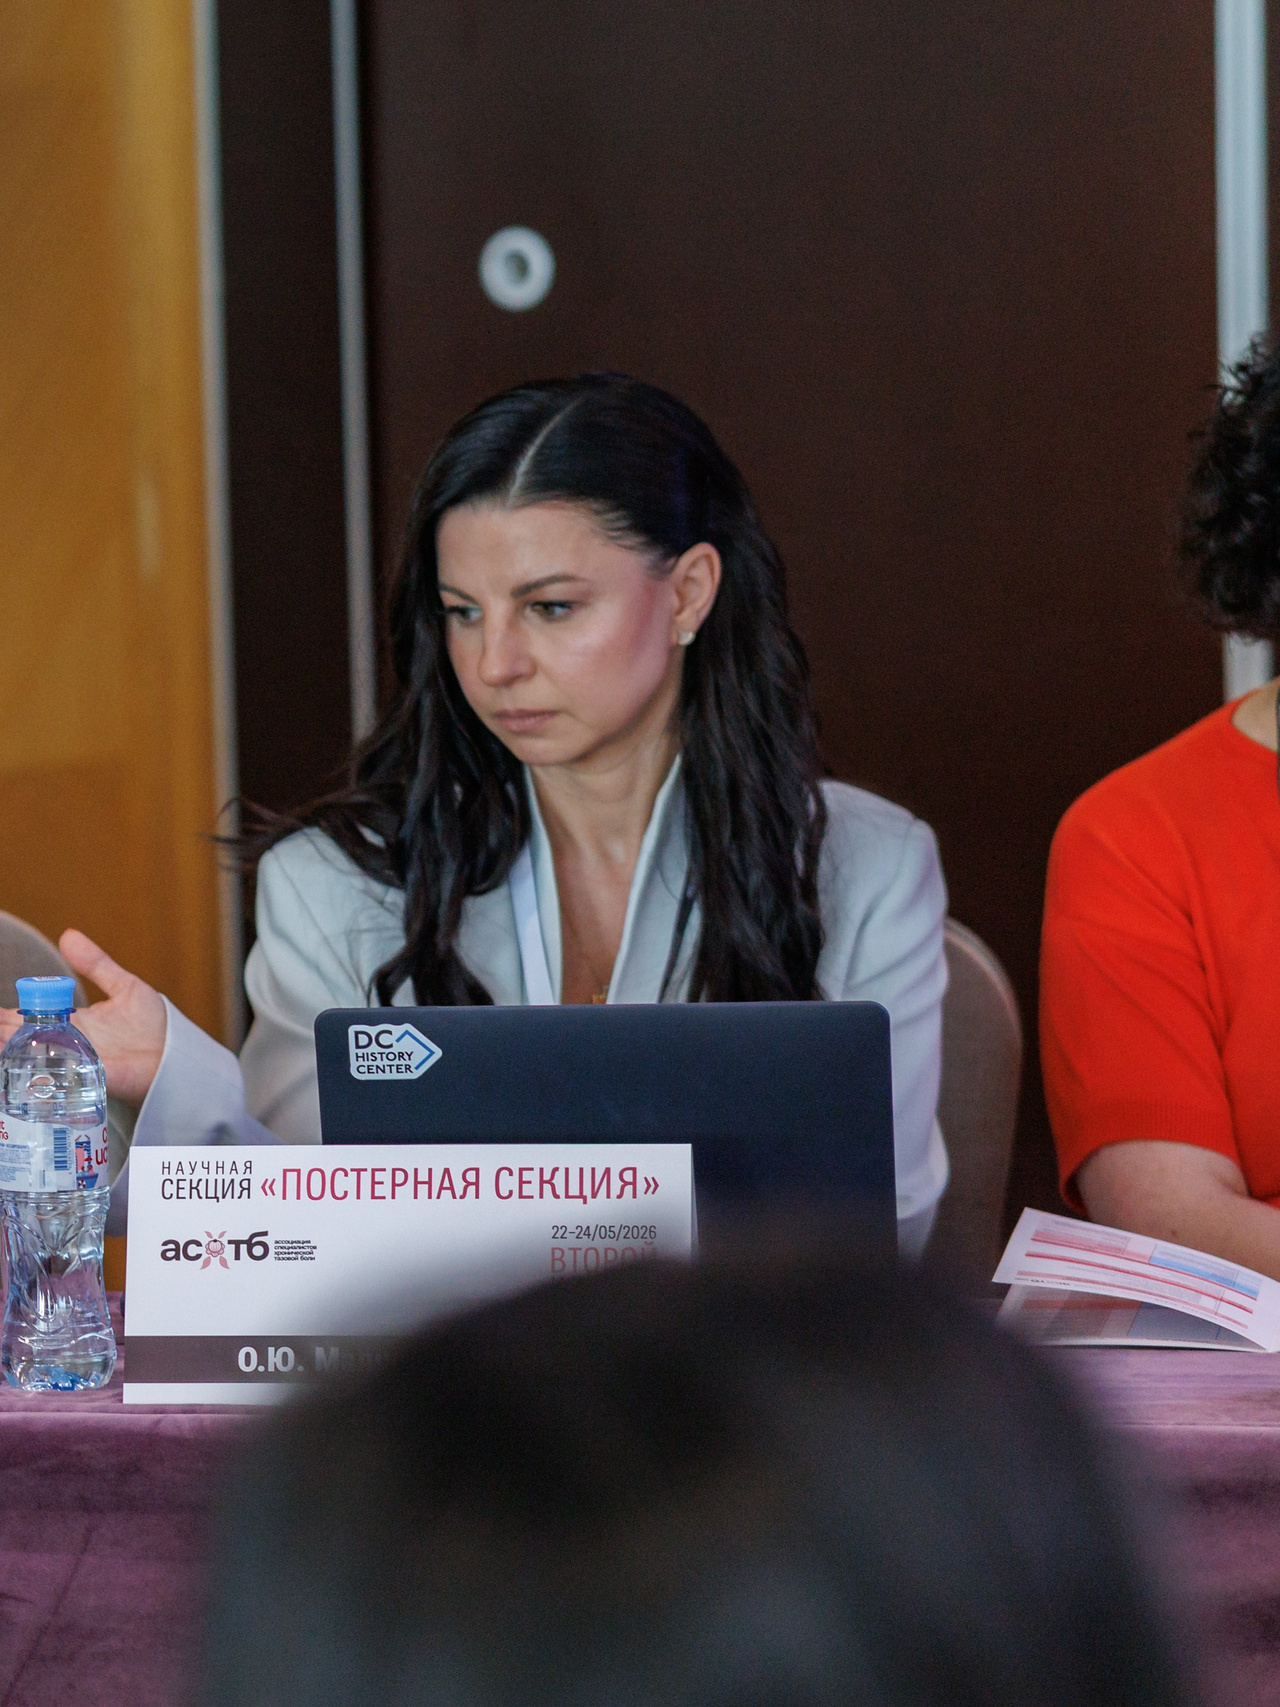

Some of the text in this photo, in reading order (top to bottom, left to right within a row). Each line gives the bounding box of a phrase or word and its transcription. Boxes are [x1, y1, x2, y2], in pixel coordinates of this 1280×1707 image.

[353, 1029, 394, 1050] DC
[355, 1051, 414, 1062] HISTORY
[356, 1063, 414, 1075] CENTER
[161, 1160, 253, 1176] НАУЧНАЯ
[161, 1178, 252, 1203] СЕКЦИЯ
[260, 1166, 660, 1205] «ПОСТЕРНАЯ СЕКЦИЯ»
[237, 1346, 305, 1373] О.Ю.
